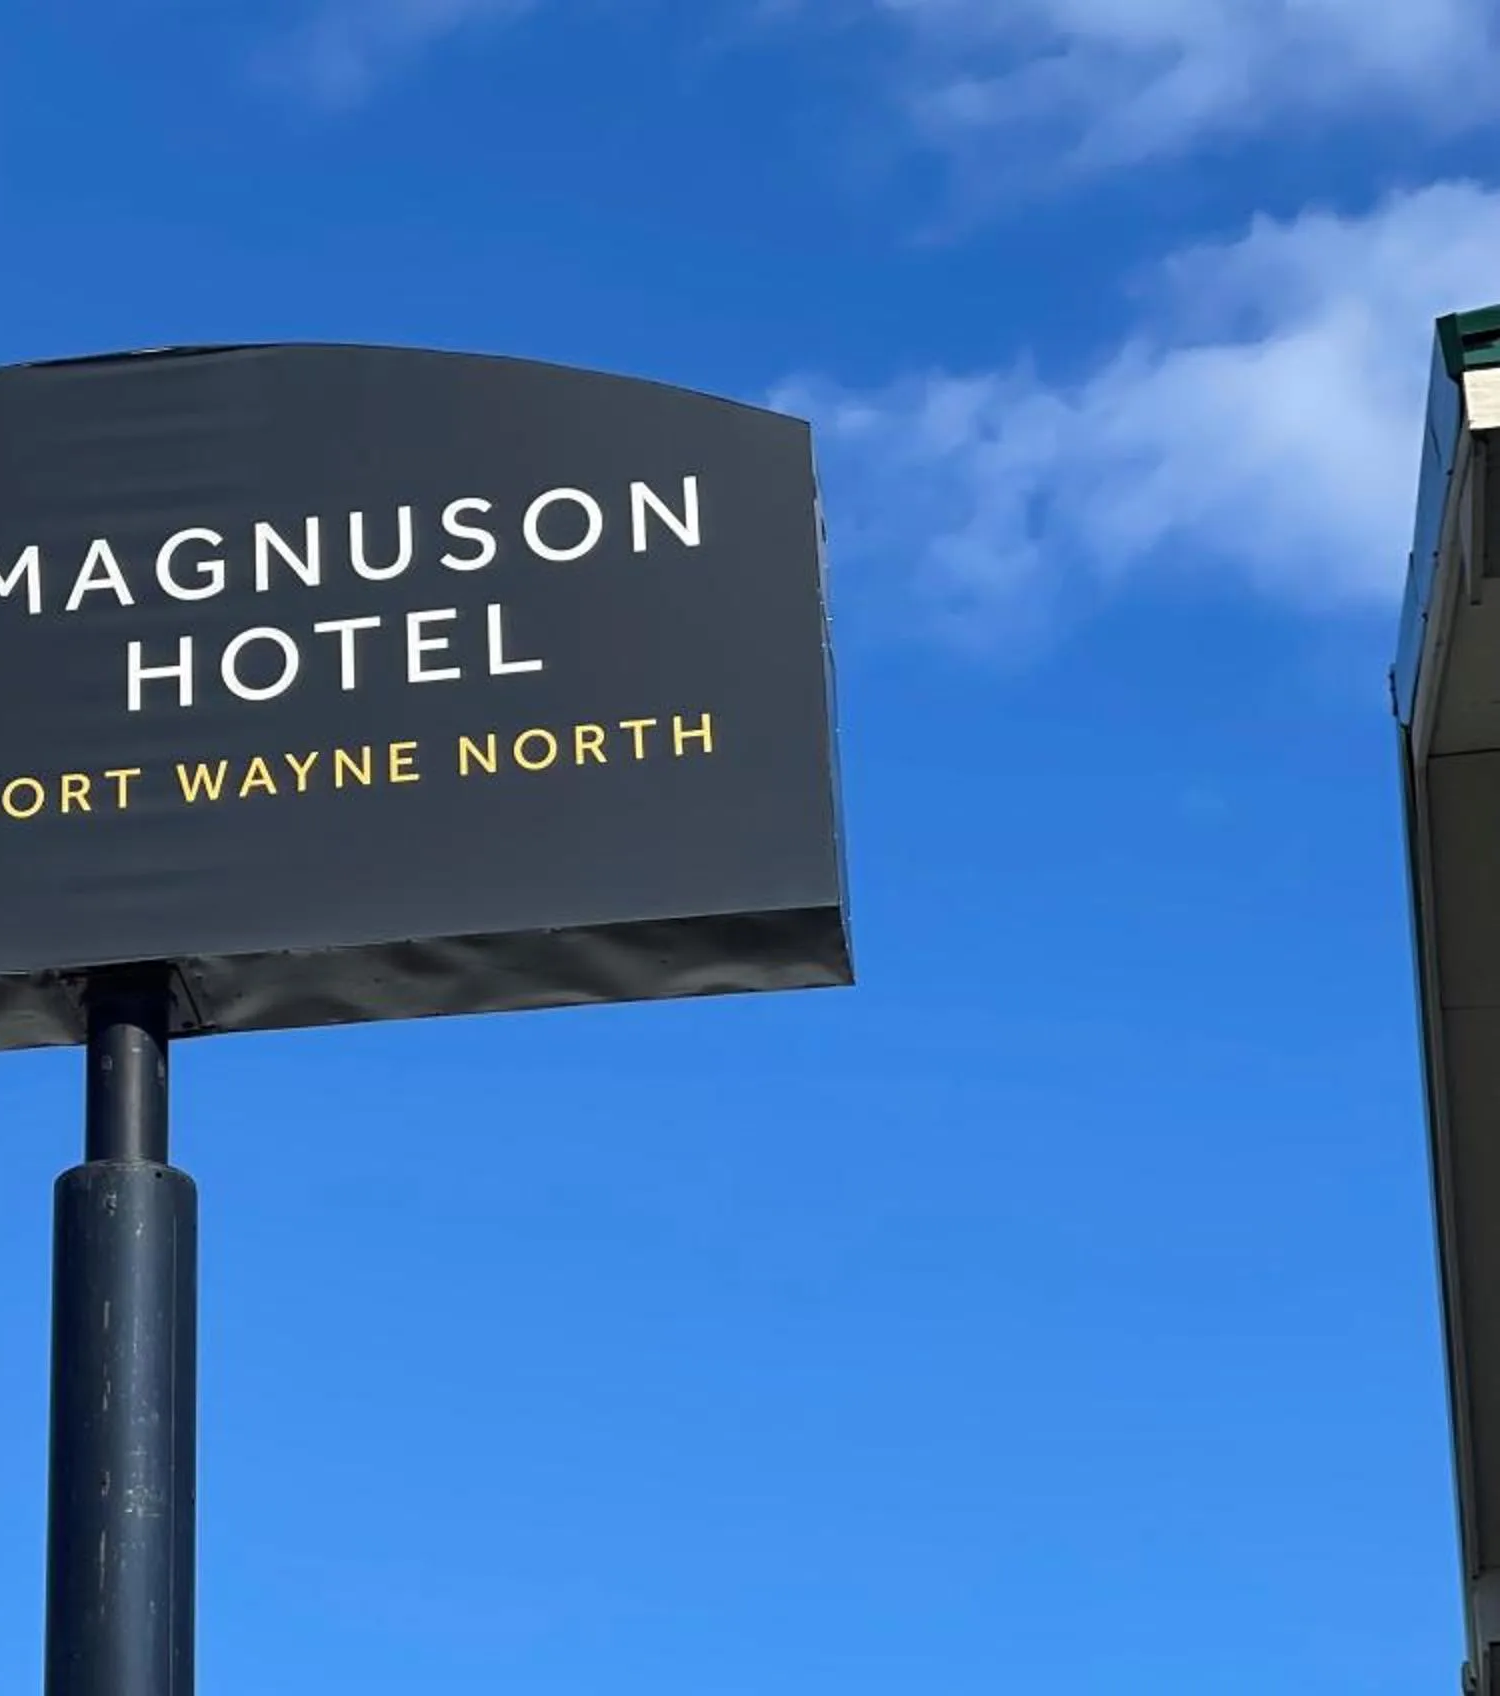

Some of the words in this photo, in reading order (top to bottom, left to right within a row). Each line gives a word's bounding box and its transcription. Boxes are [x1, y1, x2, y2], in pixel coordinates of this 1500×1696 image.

[126, 602, 544, 713] HOTEL
[175, 740, 421, 804] WAYNE
[457, 711, 714, 778] NORTH
